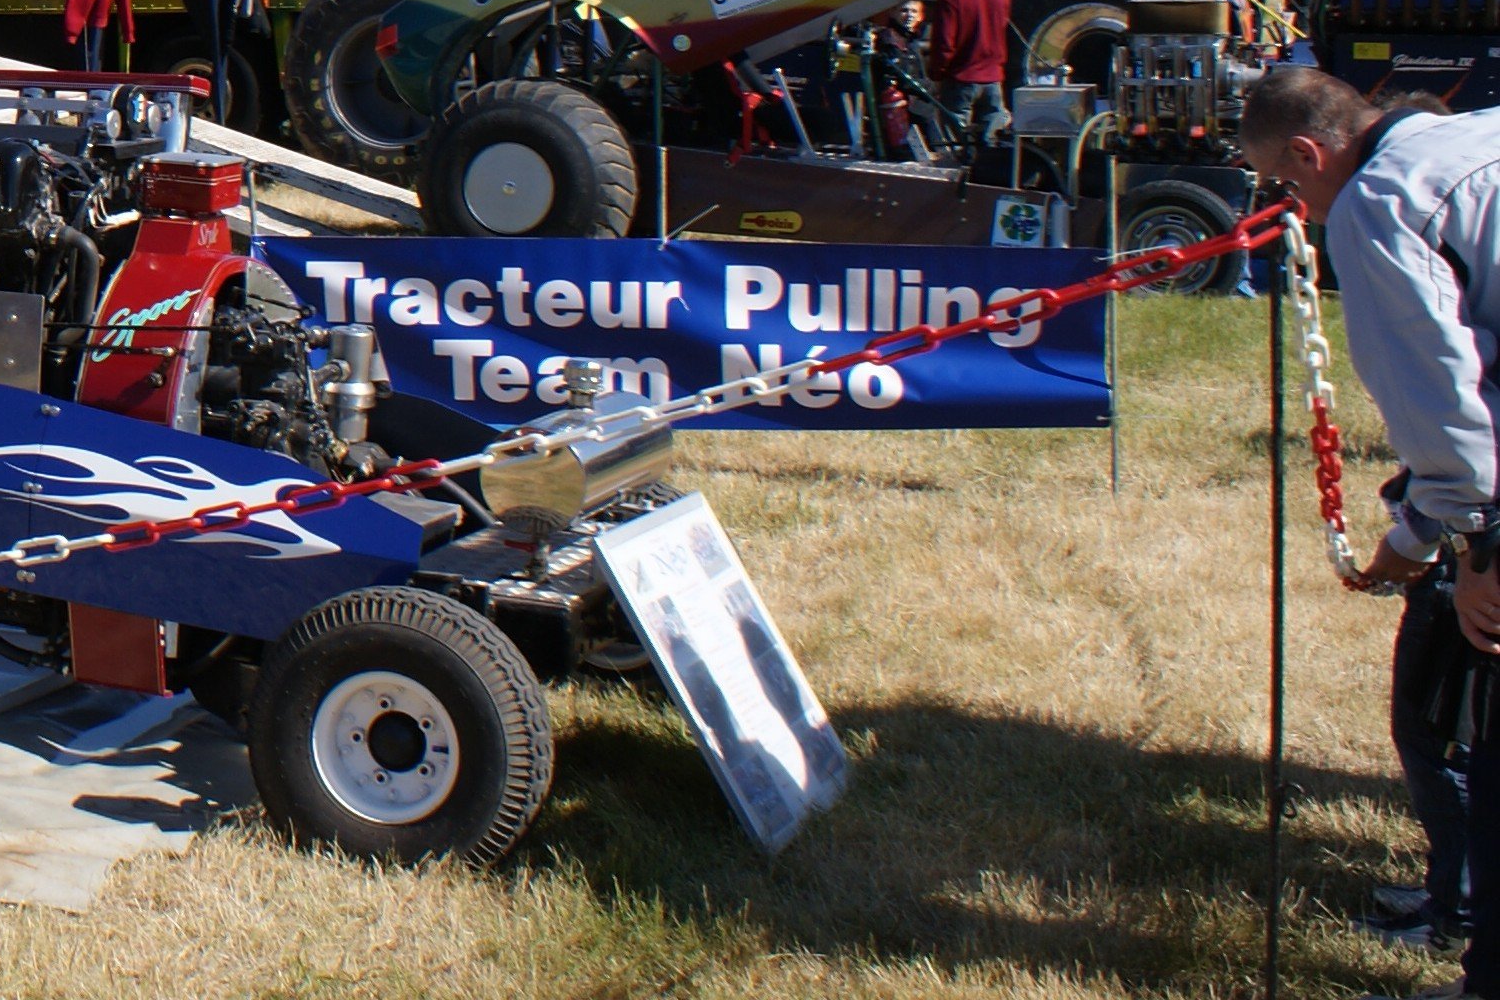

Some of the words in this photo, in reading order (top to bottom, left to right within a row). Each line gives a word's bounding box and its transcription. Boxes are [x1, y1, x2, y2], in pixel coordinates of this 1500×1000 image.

[305, 261, 682, 329] Tracteur
[725, 265, 1043, 348] Pulling
[433, 339, 671, 402] Team
[721, 344, 904, 410] Néo
